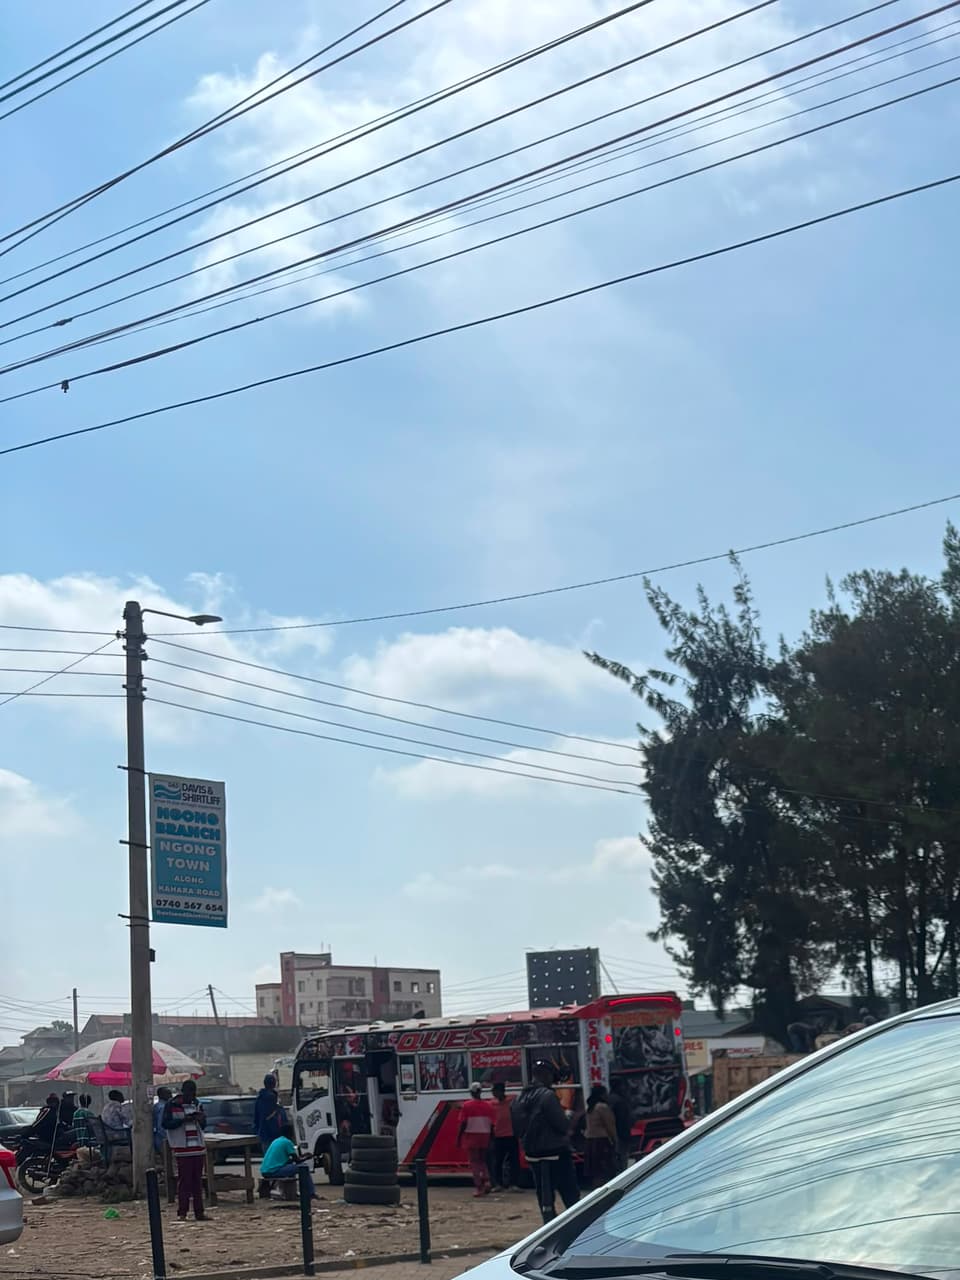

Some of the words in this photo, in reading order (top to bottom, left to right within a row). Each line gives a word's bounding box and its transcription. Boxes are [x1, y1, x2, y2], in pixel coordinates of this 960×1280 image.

[182, 783, 206, 794] DAVIS
[207, 786, 214, 795] &
[157, 806, 219, 825] NGONG
[156, 822, 220, 841] BRANCH
[160, 841, 216, 856] NGONG
[167, 858, 209, 871] TOWN
[174, 875, 204, 884] ALONG
[196, 888, 220, 897] ROAD
[156, 899, 181, 908] 0740
[184, 902, 202, 910] 567
[205, 904, 223, 912] 654
[588, 1020, 602, 1087] SAIN
